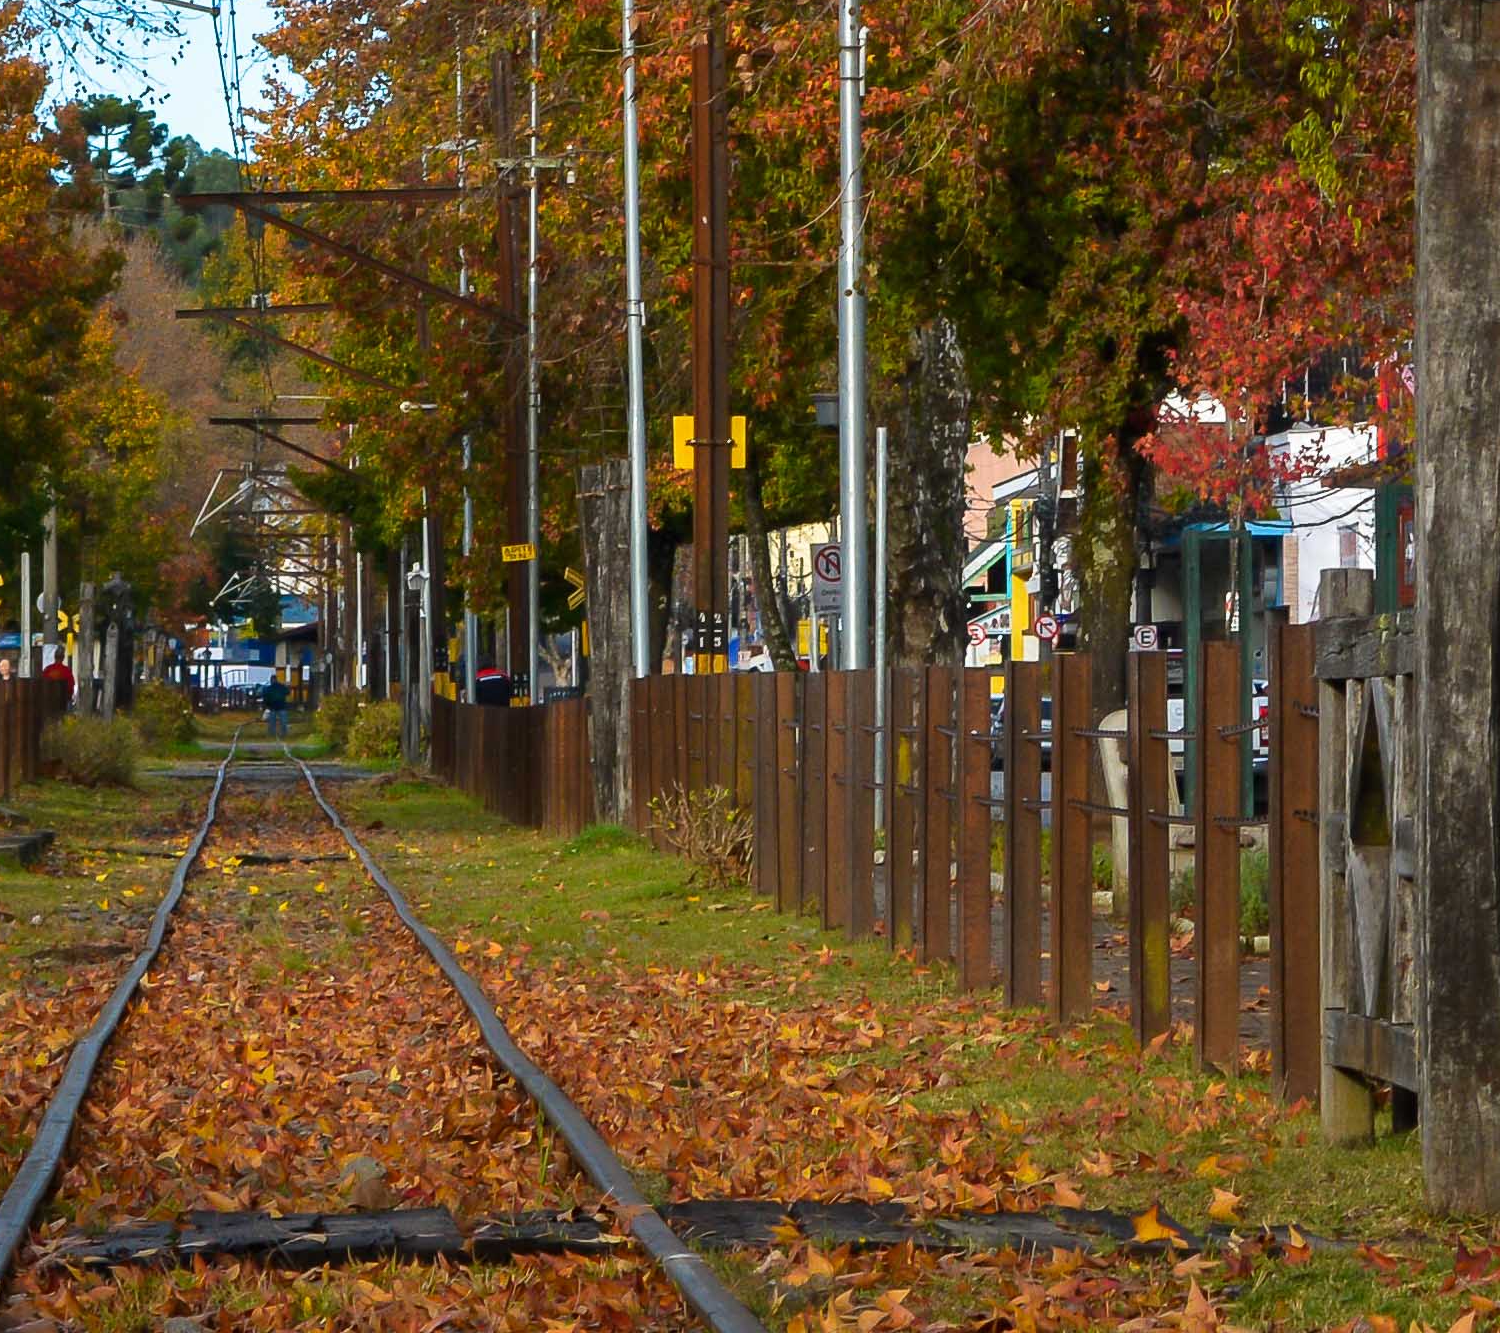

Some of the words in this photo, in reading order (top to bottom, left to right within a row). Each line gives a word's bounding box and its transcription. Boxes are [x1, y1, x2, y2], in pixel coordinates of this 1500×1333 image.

[714, 613, 722, 623] 2
[699, 637, 704, 648] 1
[1141, 630, 1151, 644] E
